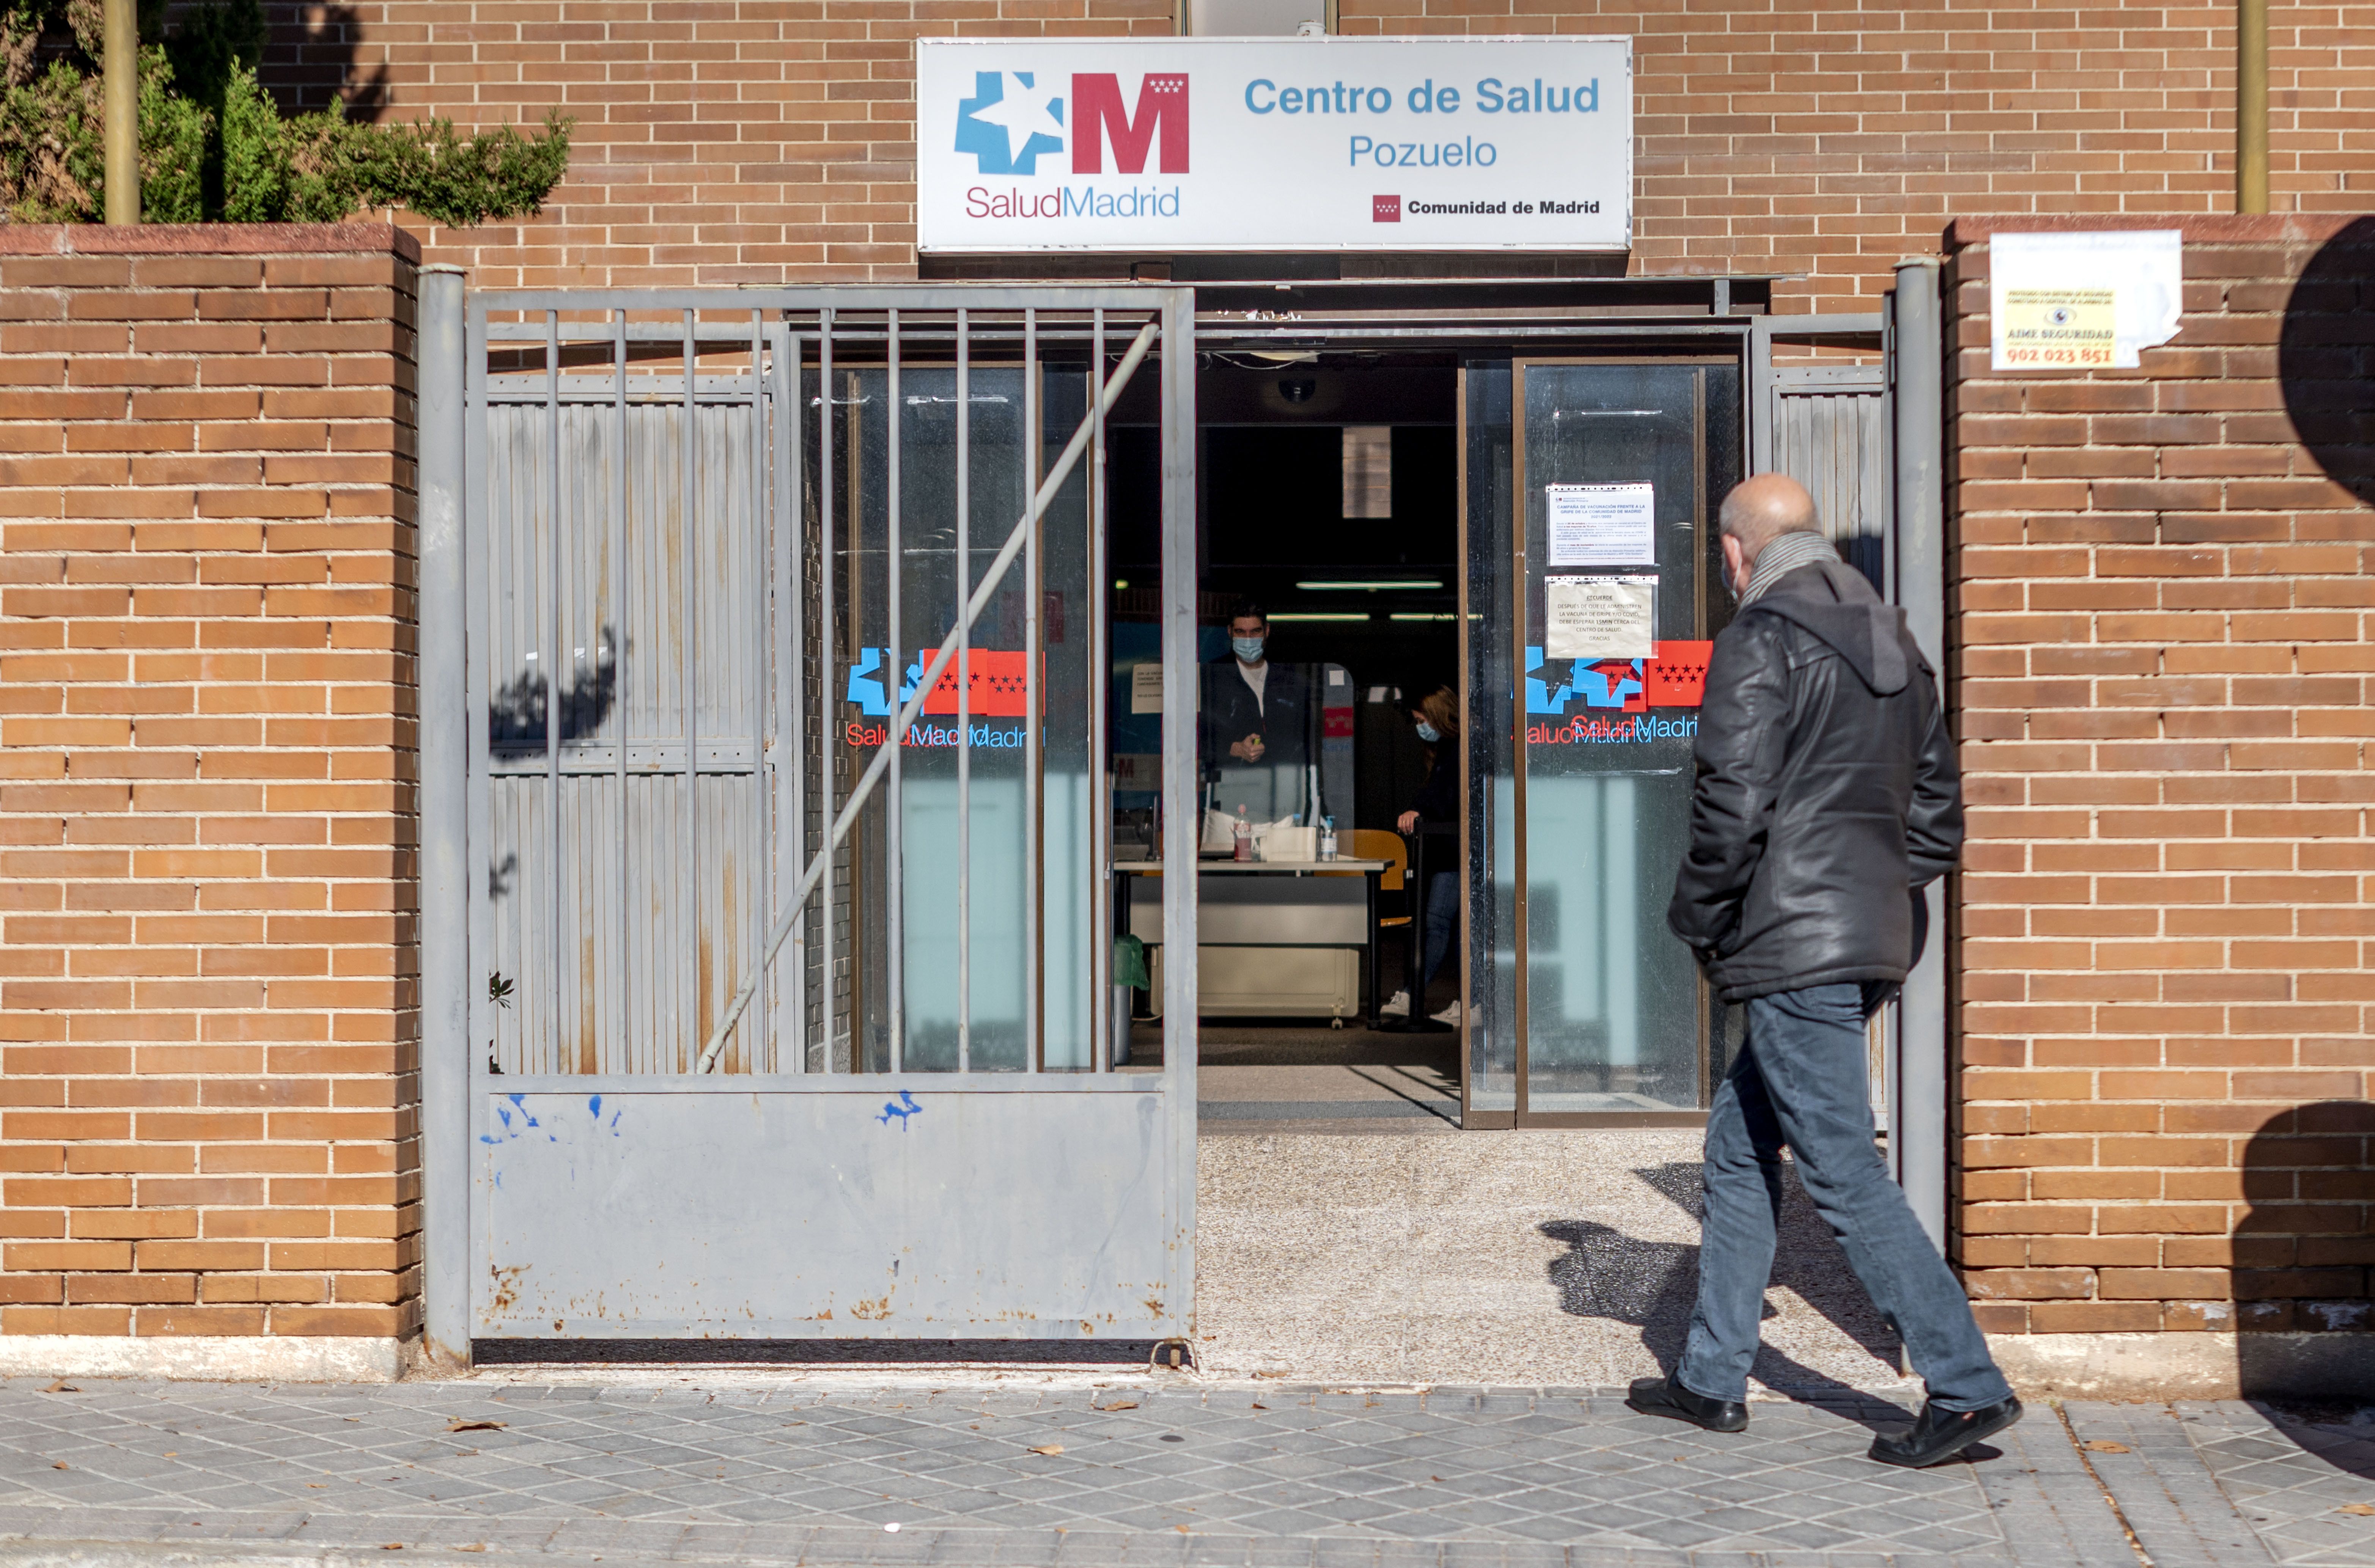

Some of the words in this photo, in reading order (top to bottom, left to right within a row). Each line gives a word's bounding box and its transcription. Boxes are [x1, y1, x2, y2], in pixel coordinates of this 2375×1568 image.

[1245, 79, 1392, 114] Centro
[1408, 79, 1460, 114] de
[1476, 78, 1598, 113] Salud
[1350, 135, 1496, 167] Pozuelo
[1408, 201, 1506, 214] Comunidad
[1513, 201, 1533, 214] de
[1540, 201, 1599, 214] Madrid
[2007, 329, 2038, 339] AIME
[2041, 329, 2114, 339] SEGURIDAD
[2007, 349, 2039, 363] 902
[2044, 349, 2076, 363] 023
[2081, 348, 2112, 363] 851
